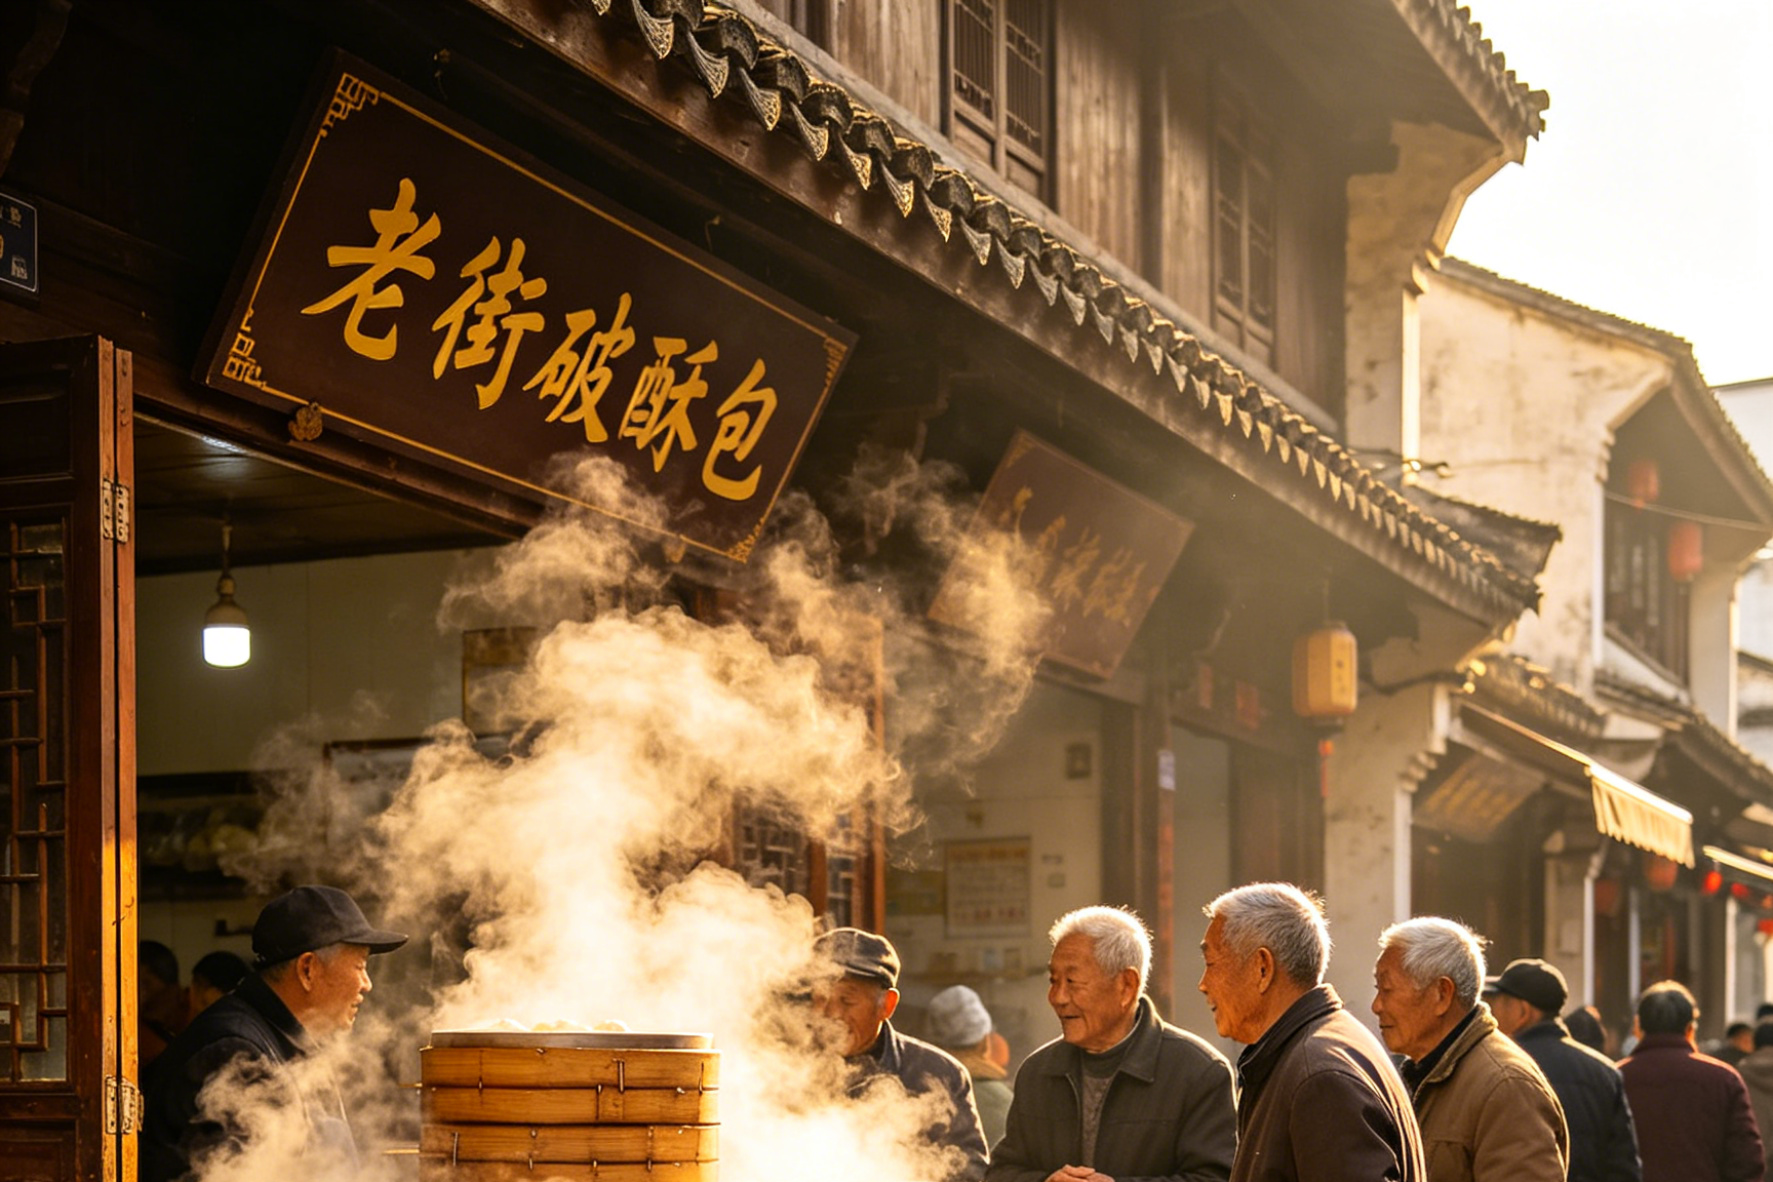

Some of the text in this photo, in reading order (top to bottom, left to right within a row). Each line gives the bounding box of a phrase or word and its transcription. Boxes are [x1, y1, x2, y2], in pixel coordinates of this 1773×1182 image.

[301, 178, 777, 501] 老街破酥包
